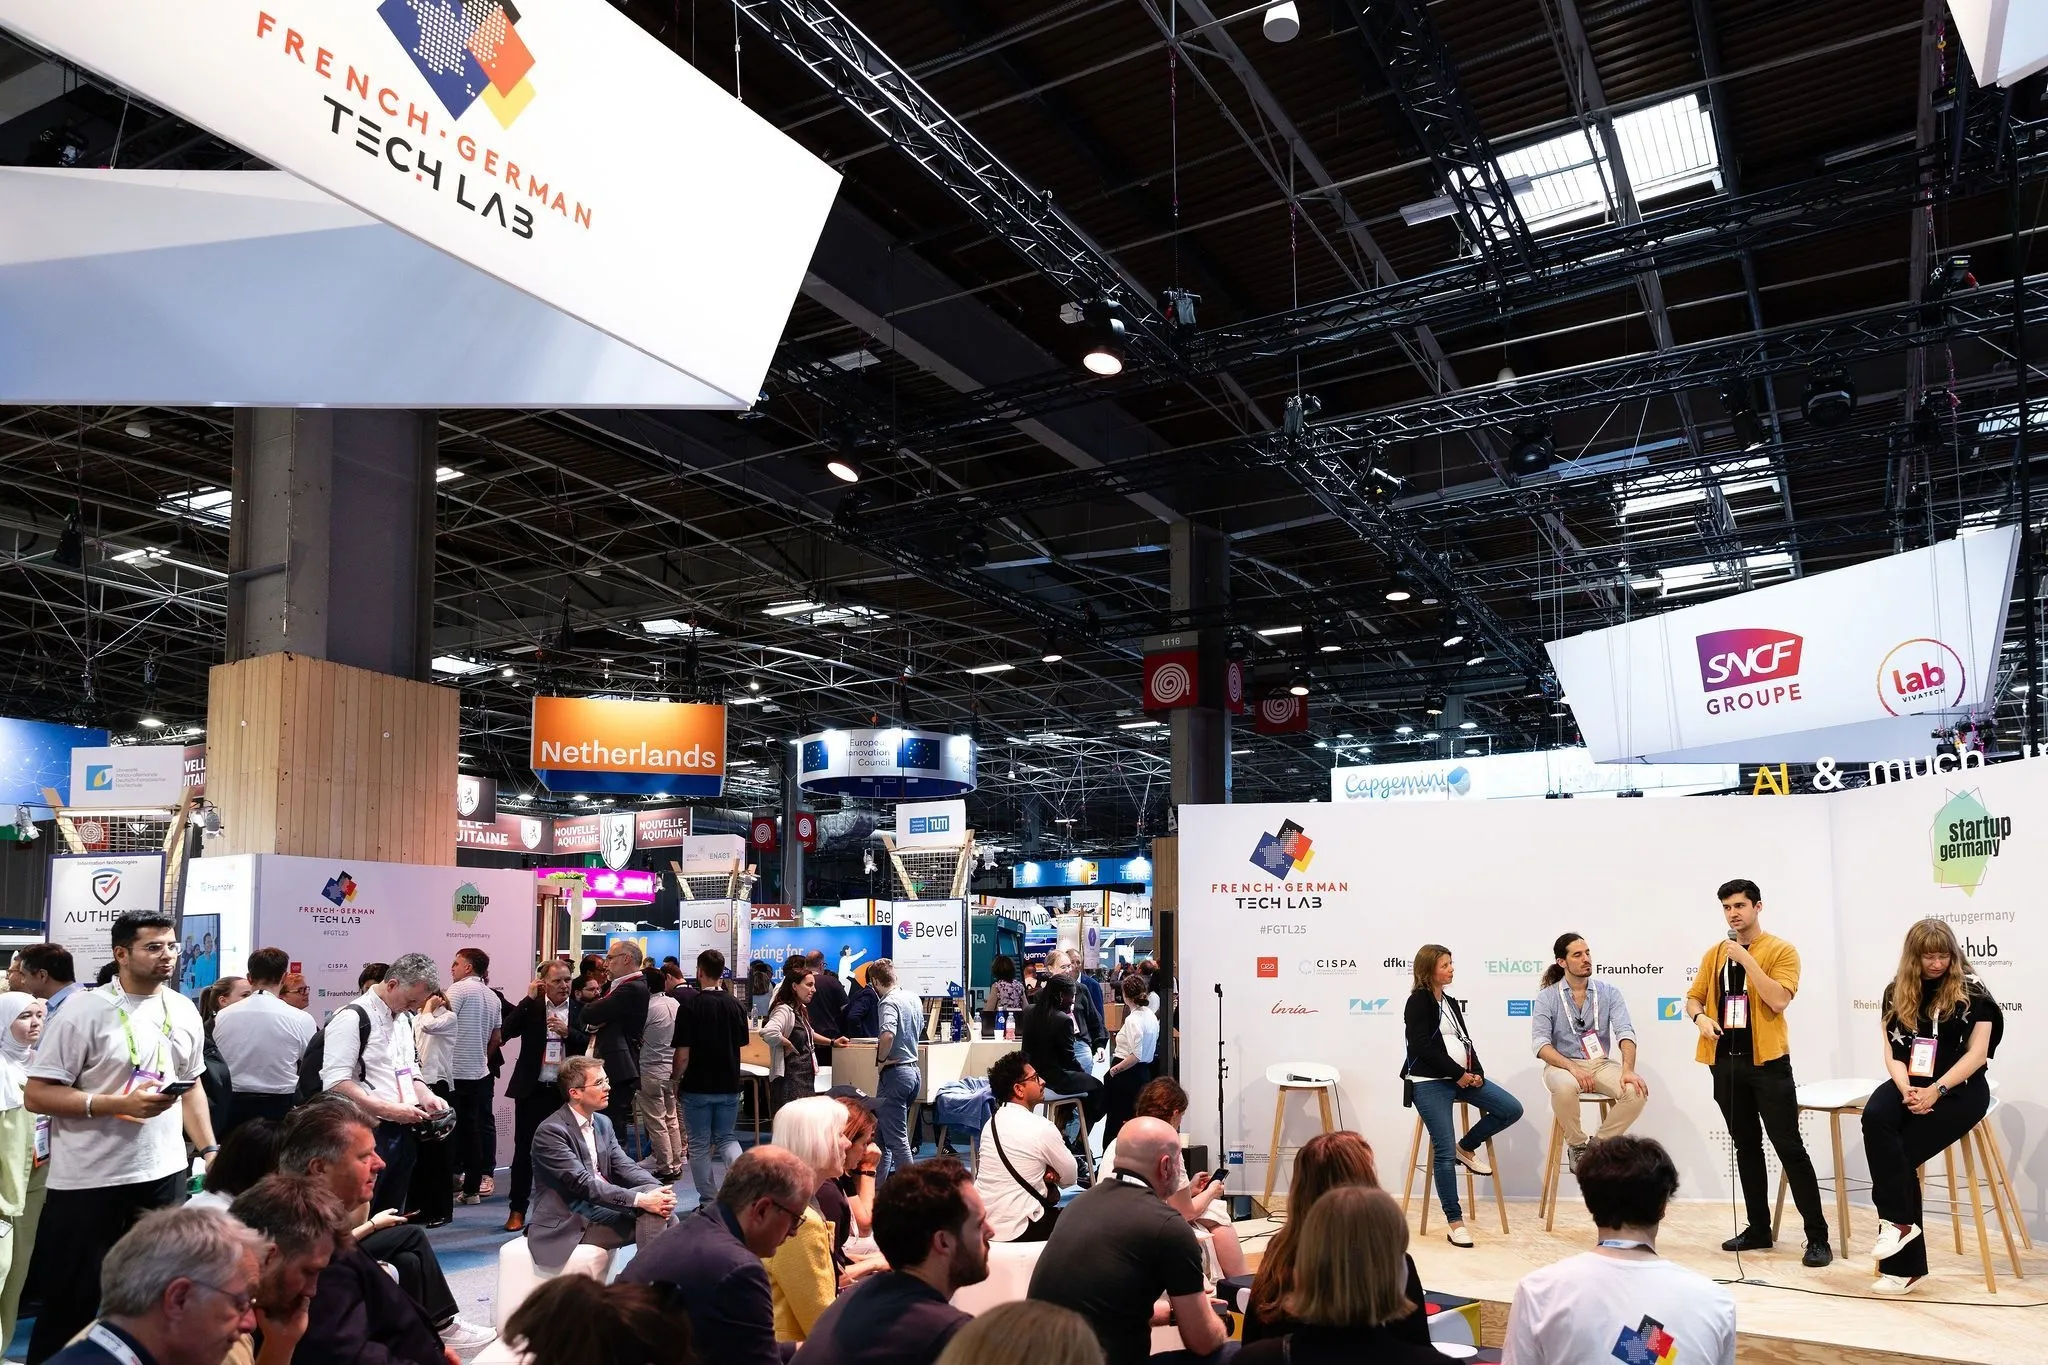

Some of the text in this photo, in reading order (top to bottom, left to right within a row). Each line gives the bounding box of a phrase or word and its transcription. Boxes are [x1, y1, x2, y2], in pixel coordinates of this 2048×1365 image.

[324, 94, 534, 240] TECH LAB
[1161, 637, 1181, 648] 1116
[1706, 639, 1797, 684] SNCF
[1892, 662, 1946, 695] lab
[1706, 683, 1802, 716] GROUPE
[1902, 687, 1946, 703] VIVATECH
[541, 740, 716, 768] Netherlands
[858, 758, 890, 767] Council
[1752, 762, 1790, 796] AI
[1812, 756, 1846, 791] &
[1868, 742, 1985, 787] much
[1345, 769, 1447, 798] Capgemini
[639, 817, 687, 831] NOUVELLE-
[1949, 815, 2012, 843] startup
[555, 825, 599, 838] NOUVELLE-
[641, 828, 688, 841] AQUITAINE
[557, 834, 600, 847] AQUITAINE
[1940, 838, 2001, 862] germany
[461, 894, 490, 906] startup
[1235, 897, 1323, 909] TECH LAB
[456, 904, 485, 912] germany
[64, 910, 127, 923] AUTHE
[312, 915, 361, 924] TECH LAB
[681, 918, 726, 929] PUBLIC IA
[915, 920, 958, 938] Bevel
[1259, 925, 1307, 935] #FGTL25
[1316, 959, 1357, 968] CISPA
[1488, 960, 1543, 974] ENACT
[1596, 963, 1664, 975] Fraunhofer
